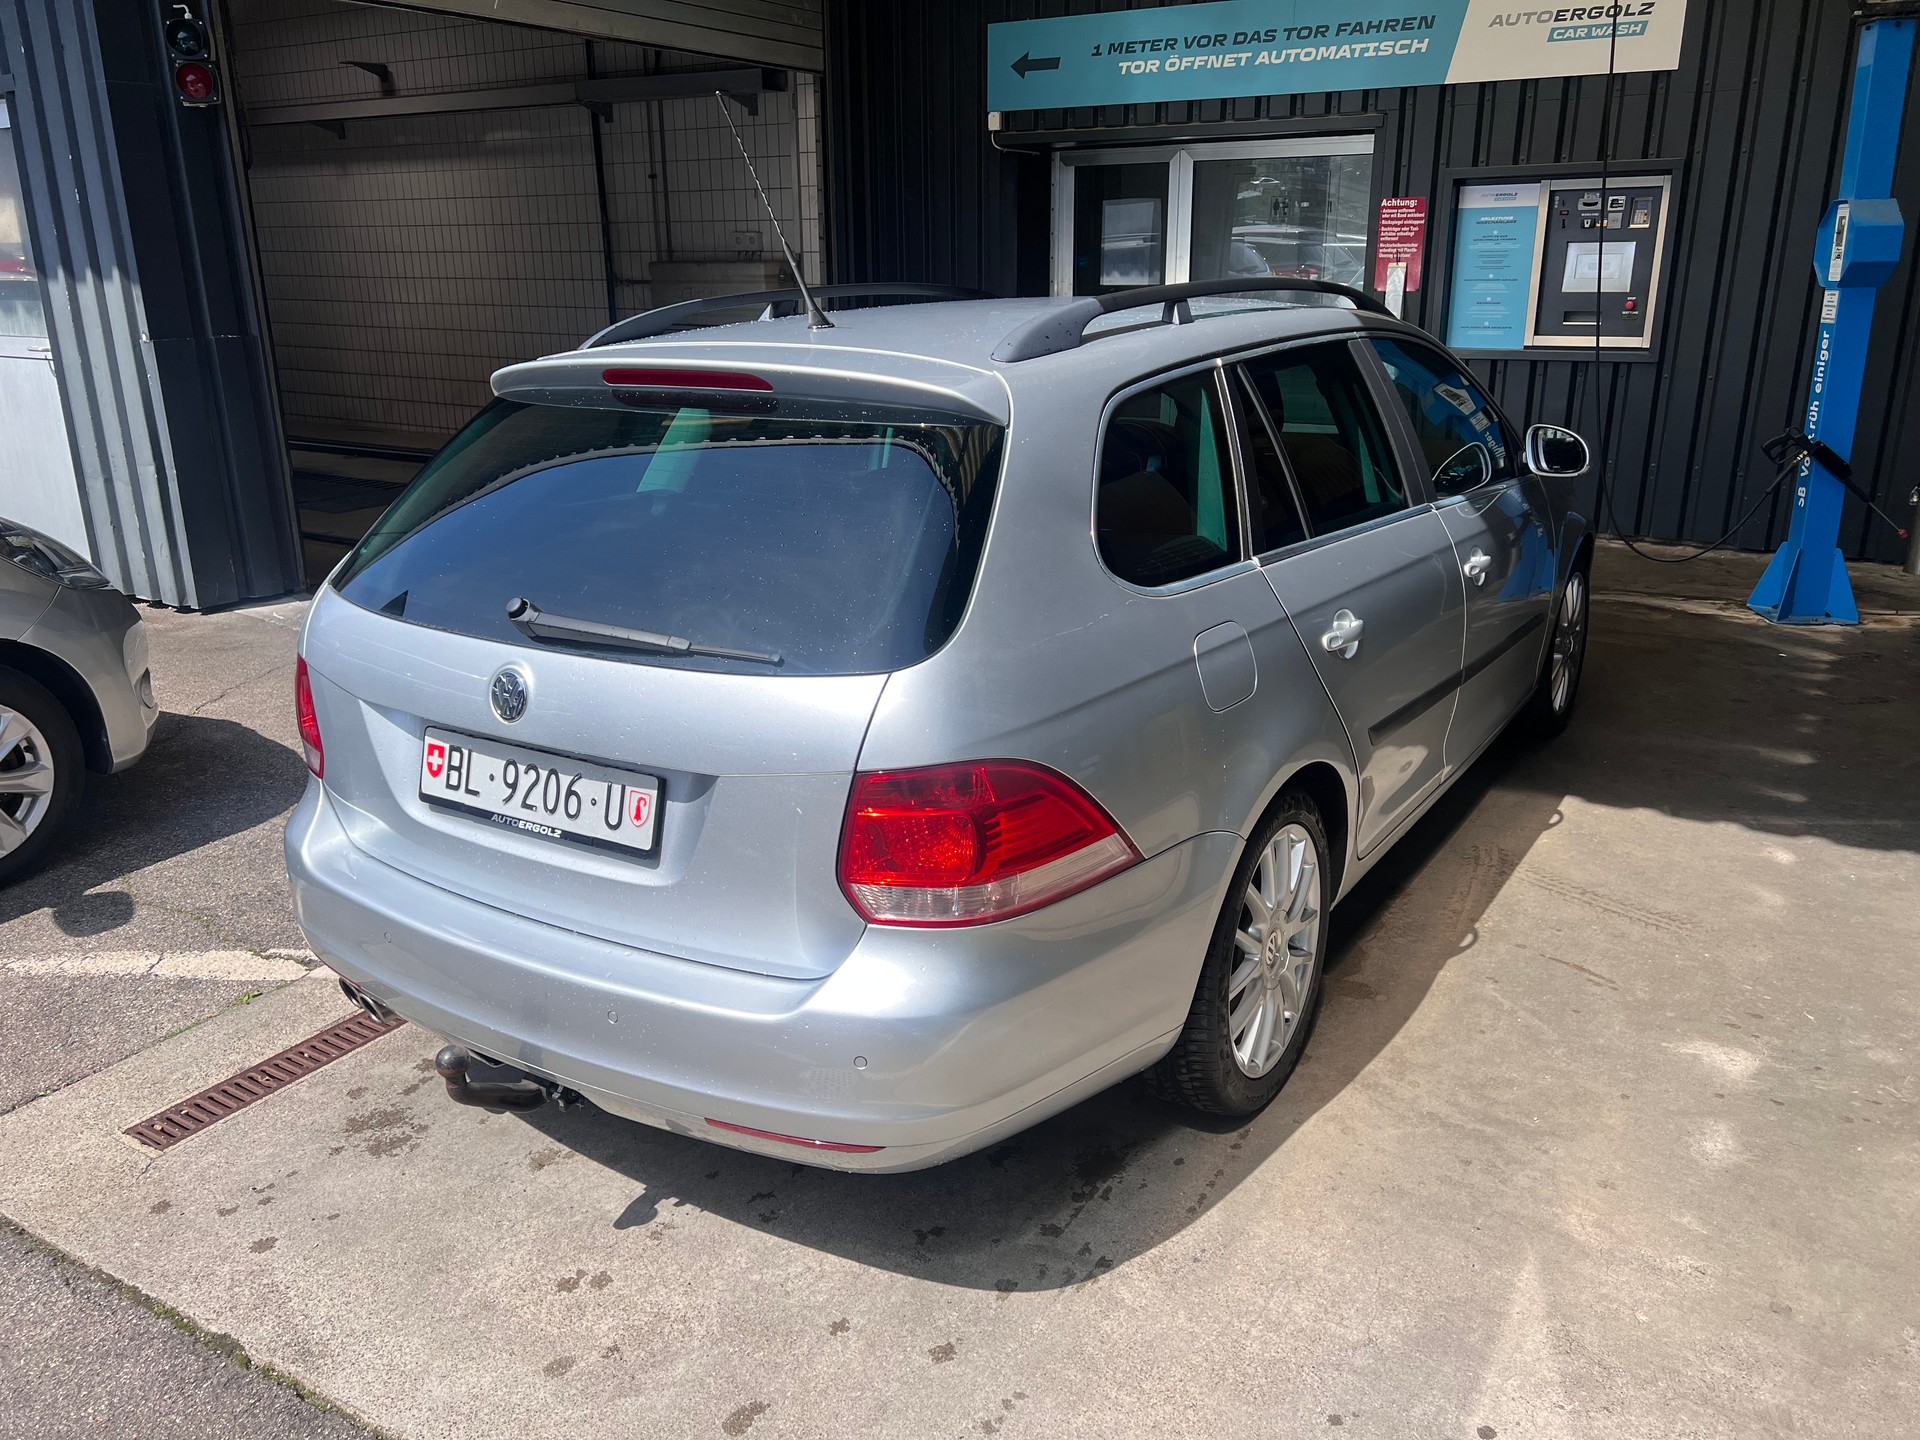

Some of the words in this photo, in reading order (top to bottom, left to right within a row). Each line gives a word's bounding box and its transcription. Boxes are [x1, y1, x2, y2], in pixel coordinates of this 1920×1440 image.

[1488, 1, 1656, 28] AUTOERGOLZ
[1091, 43, 1103, 57] 1
[1107, 36, 1180, 56] METER
[1183, 33, 1229, 50] VOR
[1232, 28, 1277, 45] DAS
[1282, 23, 1330, 41] TOR
[1335, 14, 1437, 37] FAHREN
[1551, 25, 1588, 40] CAR
[1590, 22, 1643, 38] WASH
[1118, 58, 1160, 75] TOR
[1164, 51, 1252, 73] ÖFFNET
[1254, 38, 1430, 66] AUTOMATISCH
[1381, 199, 1418, 208] Achtung:
[490, 813, 563, 838] AUTOERGOLZ
